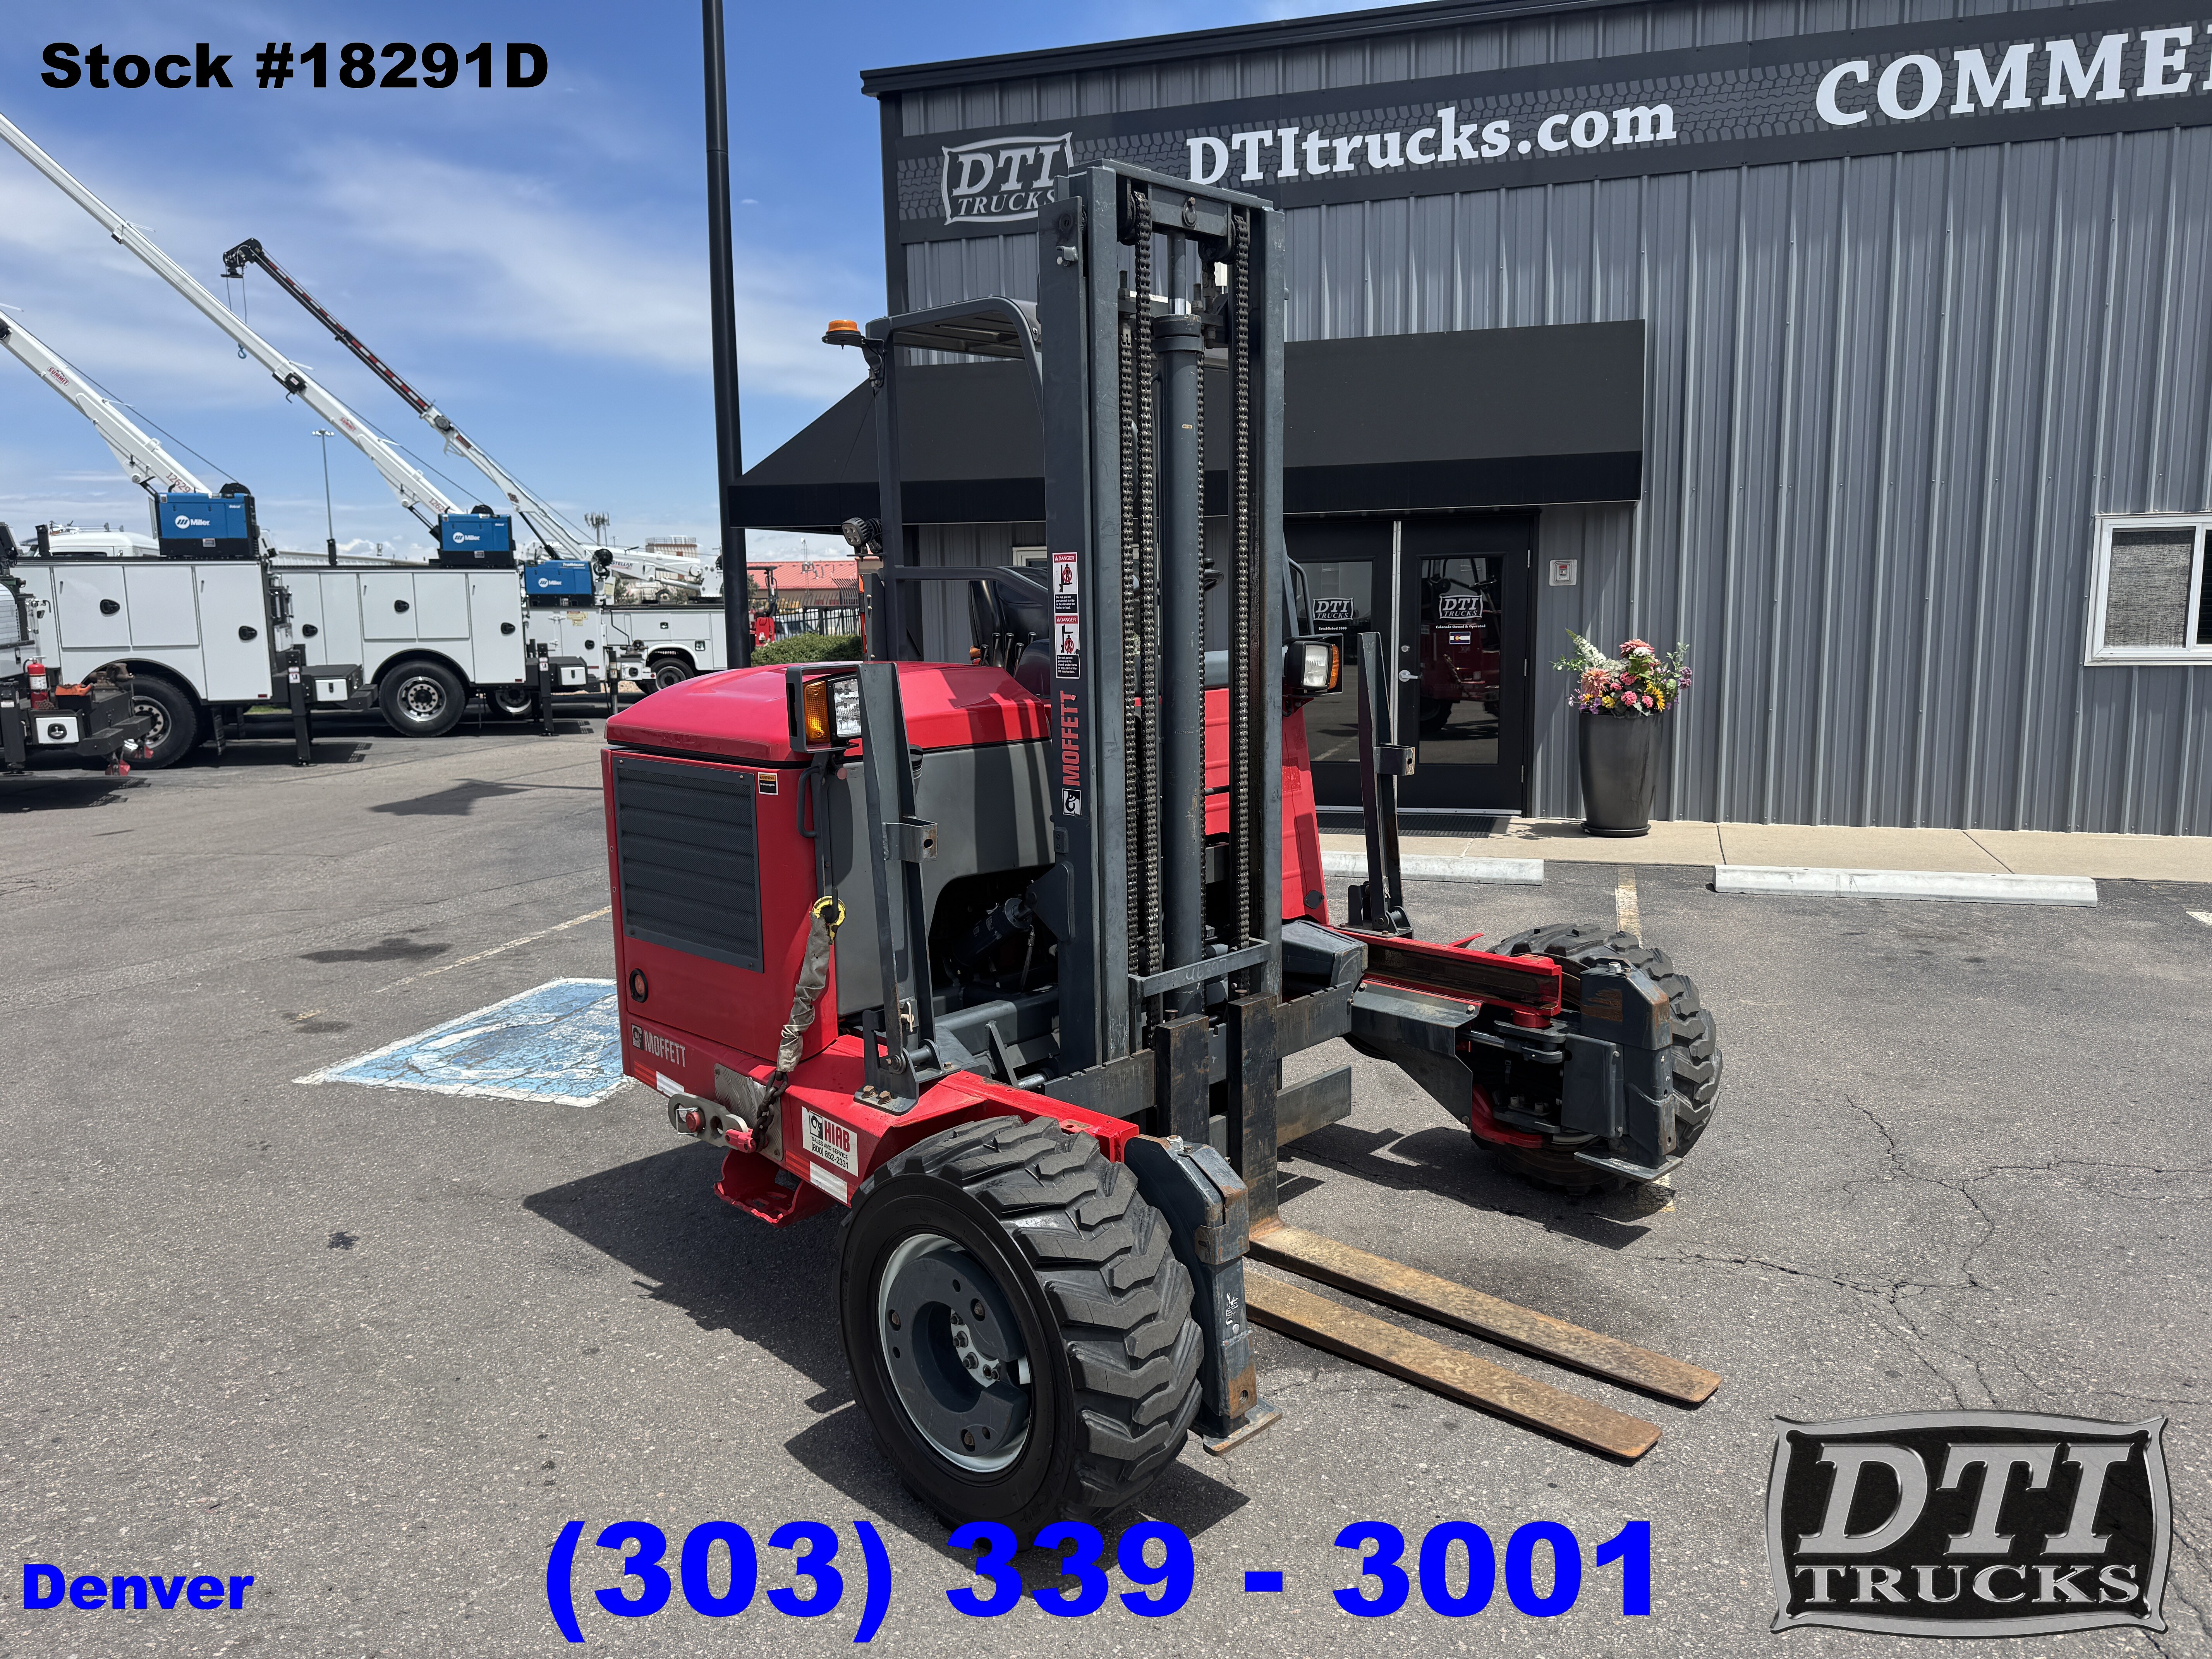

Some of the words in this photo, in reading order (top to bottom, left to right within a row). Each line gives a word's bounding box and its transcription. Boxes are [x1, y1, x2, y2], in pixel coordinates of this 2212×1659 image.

[1816, 24, 2212, 125] COMME
[1187, 104, 1677, 184] DTItrucks.com
[951, 143, 1062, 197] DTI
[958, 189, 1055, 216] TRUCKS
[1316, 601, 1350, 613] DTI
[1443, 598, 1479, 611] DTI
[1060, 690, 1080, 786] MOFFETT
[644, 1030, 685, 1067] MOFFETT
[812, 1137, 823, 1146] SALES
[833, 1148, 848, 1160] SERVICE
[824, 1120, 850, 1152] HIAB
[811, 1142, 823, 1156] (800)
[825, 1151, 848, 1169] 852-2331
